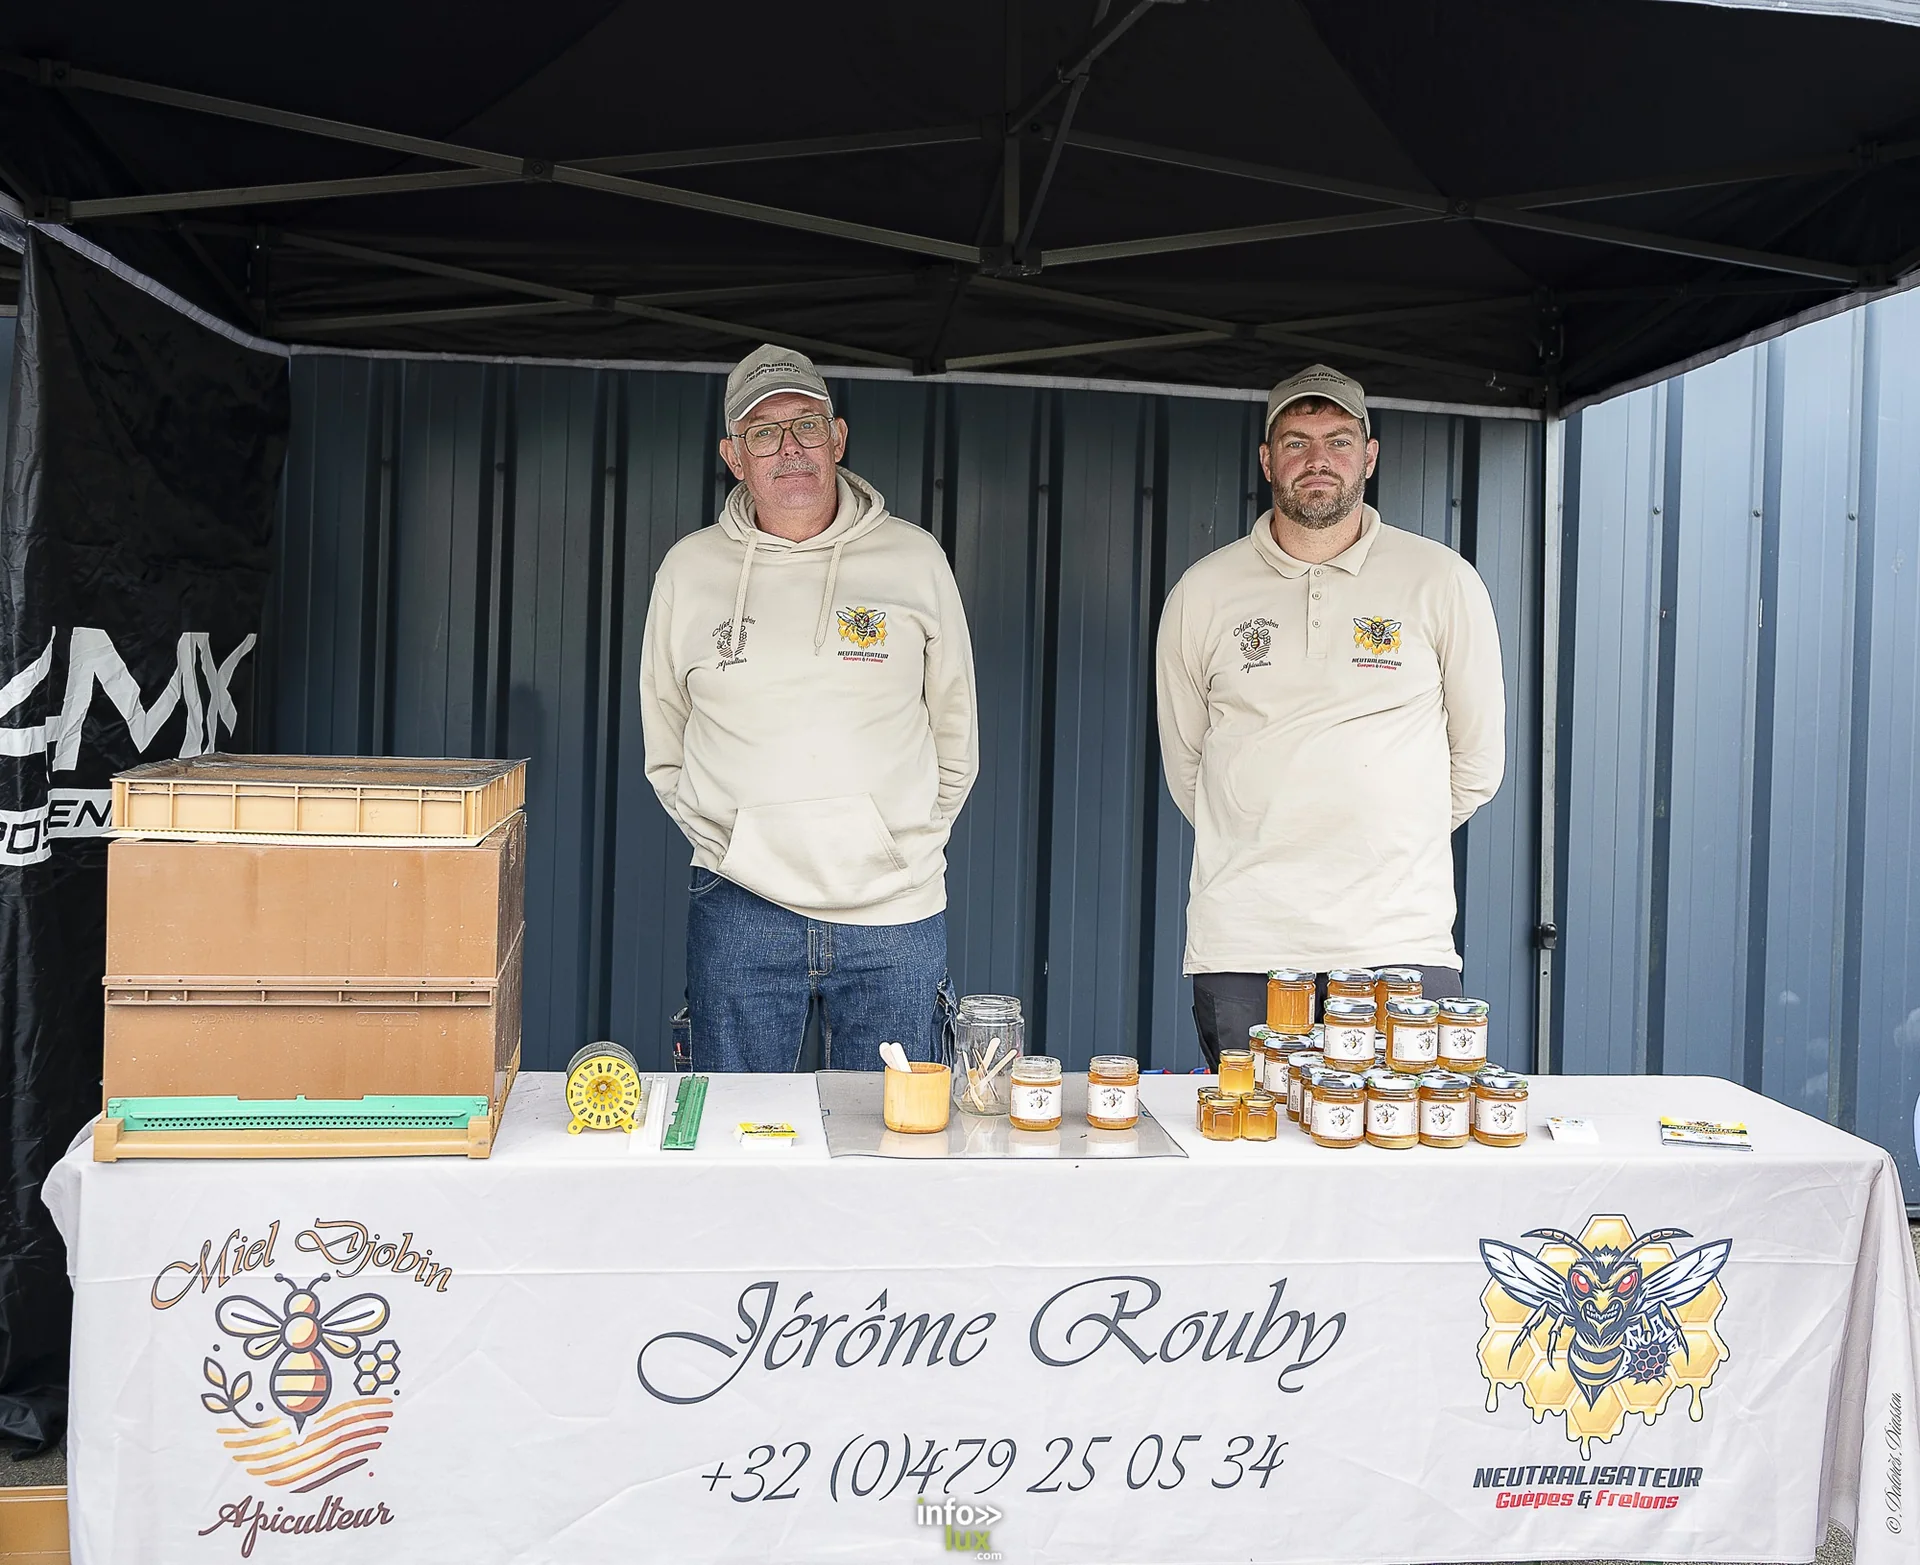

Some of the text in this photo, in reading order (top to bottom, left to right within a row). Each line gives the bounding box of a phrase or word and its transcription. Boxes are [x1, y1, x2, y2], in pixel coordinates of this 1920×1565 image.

[150, 1217, 452, 1310] Miel Djobin
[637, 1275, 1347, 1405] Jérôme Rouby
[701, 1433, 1289, 1502] +32 (0)479 25 05 34
[1473, 1465, 1704, 1488] NEUTRALISATEUR
[1495, 1489, 1679, 1509] Guèpes & Frelons
[198, 1495, 395, 1558] Apiculteur
